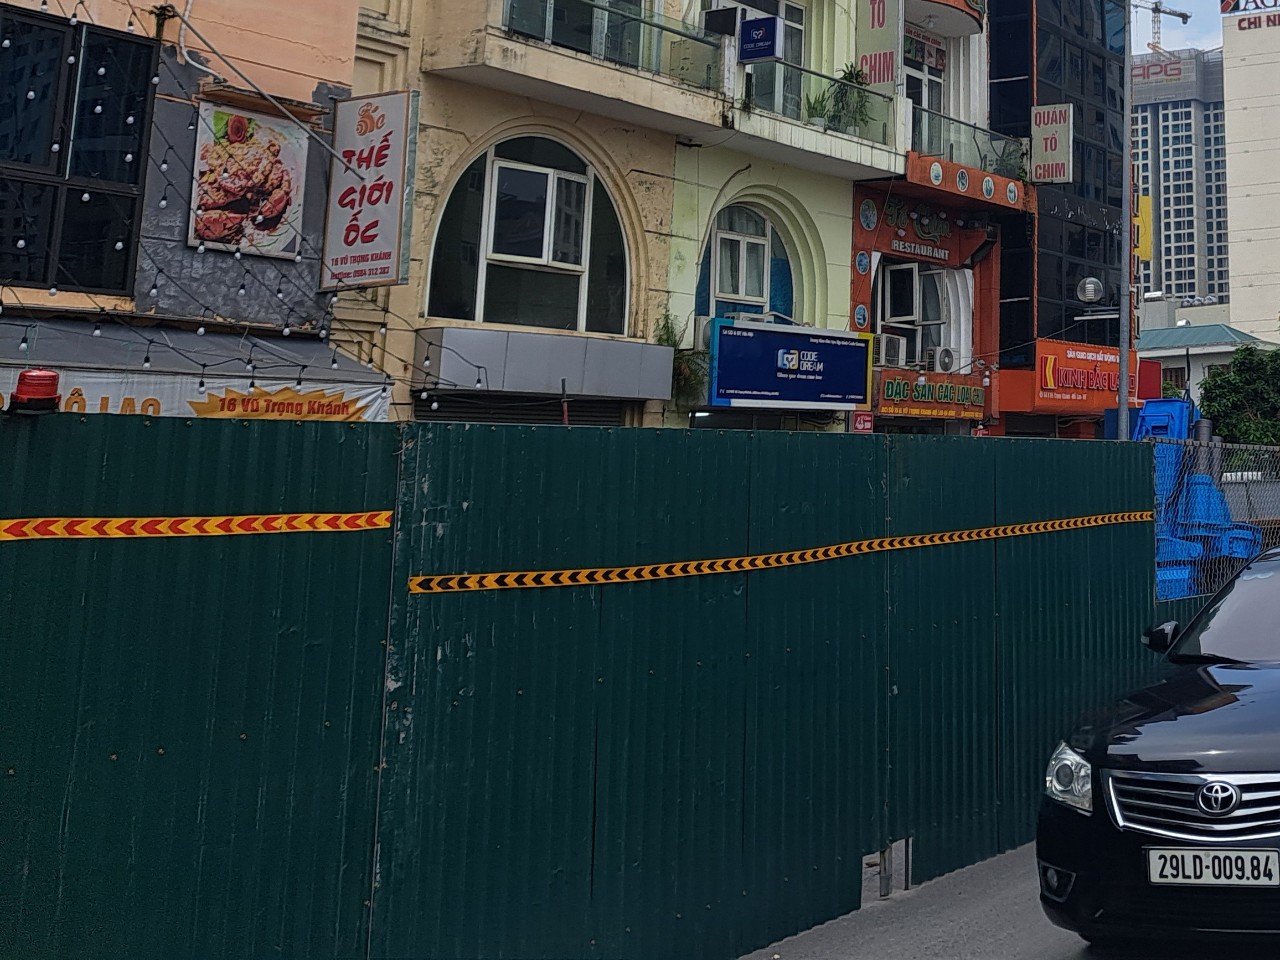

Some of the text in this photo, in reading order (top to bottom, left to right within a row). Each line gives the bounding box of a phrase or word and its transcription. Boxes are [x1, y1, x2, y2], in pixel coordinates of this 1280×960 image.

[1238, 16, 1262, 31] CHI
[860, 51, 895, 85] CHIM
[1034, 106, 1067, 128] QUÁN
[342, 130, 394, 174] THẾ
[1042, 130, 1058, 153] TỔ
[1034, 162, 1066, 180] CHIM
[337, 174, 394, 210] GIỚI
[343, 208, 380, 247] ỐC
[891, 239, 950, 261] RESTAURANT
[800, 350, 819, 361] CODE
[800, 360, 824, 372] DREAM
[1059, 367, 1088, 389] KINH
[1088, 361, 1109, 391] BẮC
[884, 376, 910, 404] ĐẶC
[219, 398, 237, 413] 16
[263, 398, 303, 417] Trọng
[306, 400, 350, 416] Khánh
[1158, 854, 1273, 882] 29LD-009.84
